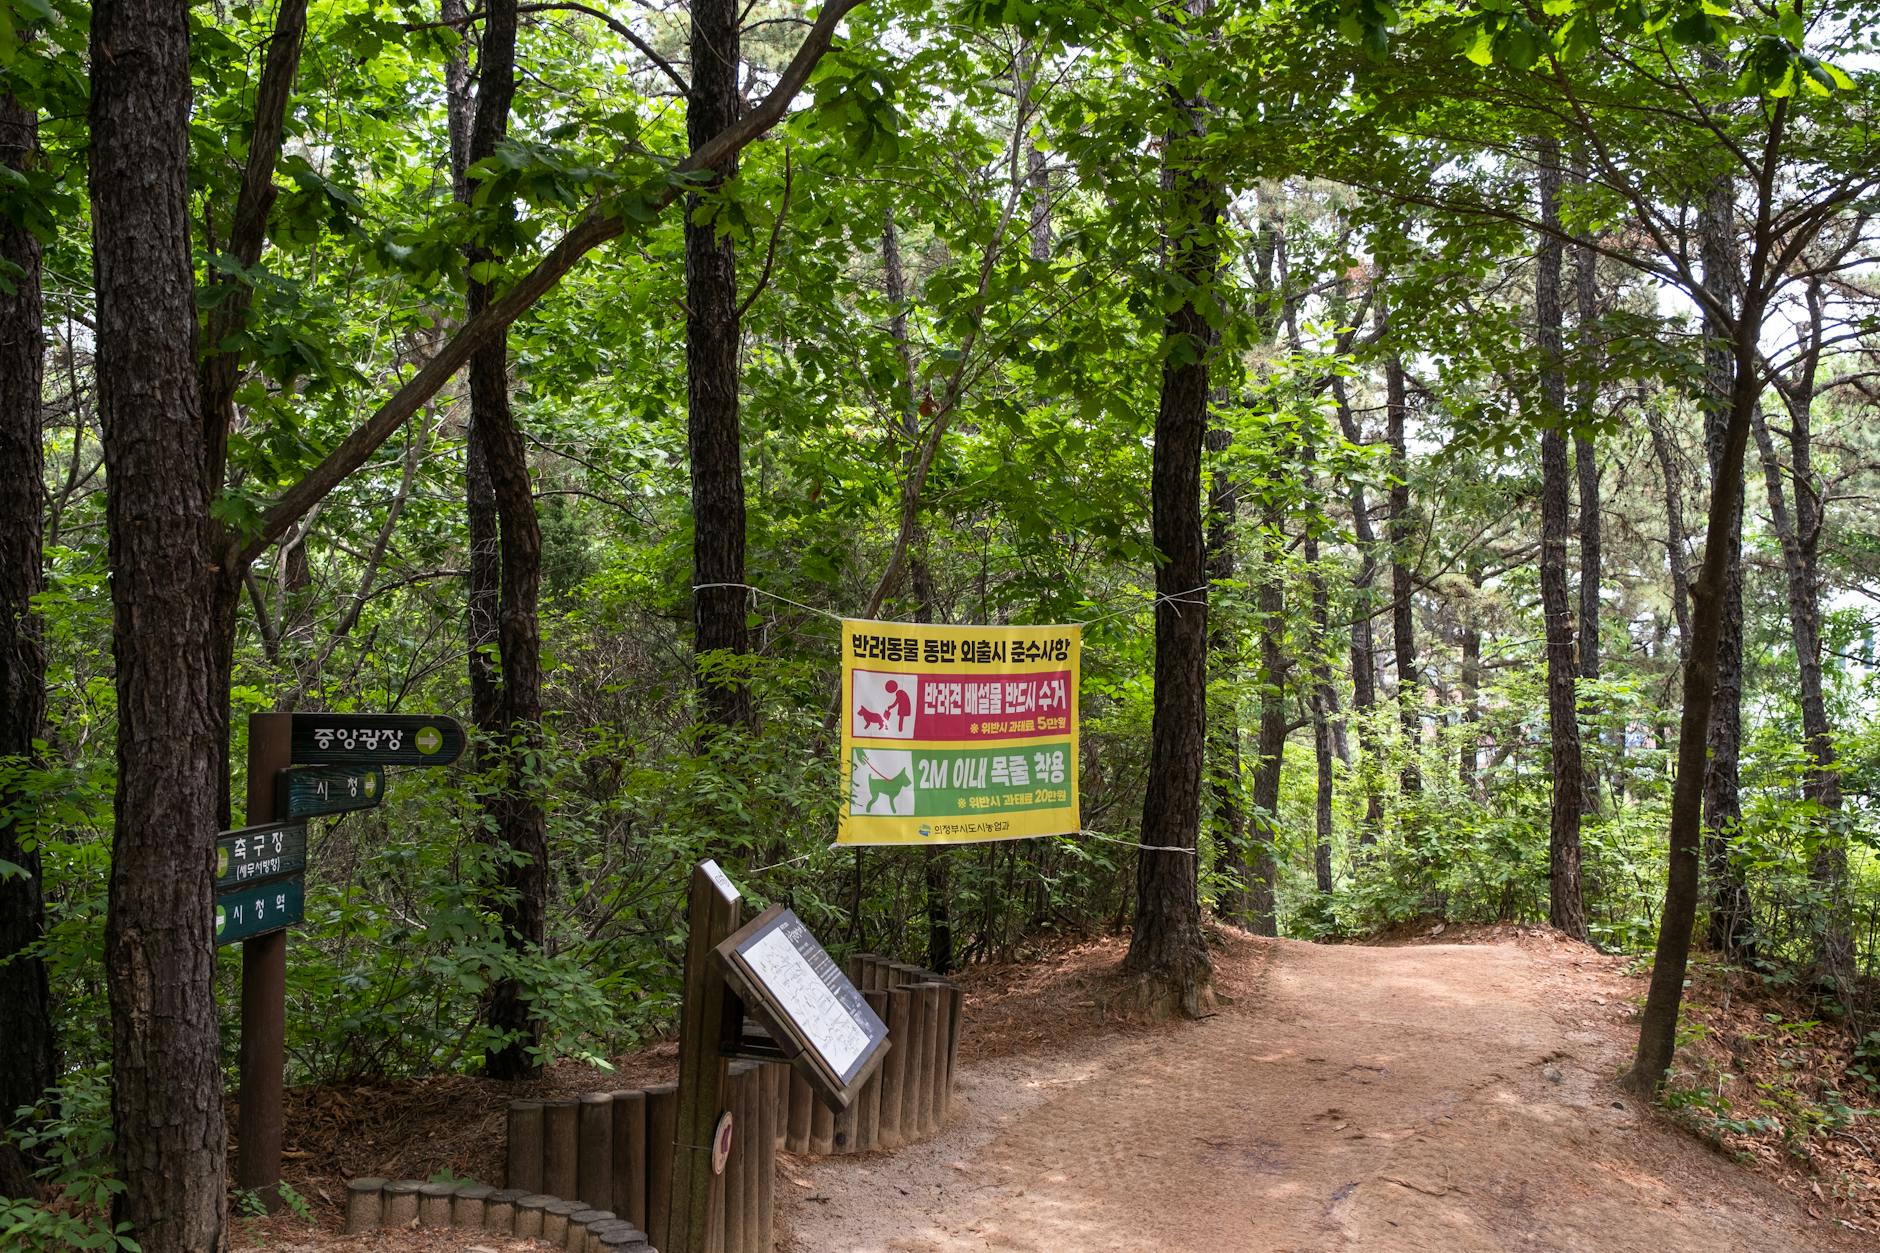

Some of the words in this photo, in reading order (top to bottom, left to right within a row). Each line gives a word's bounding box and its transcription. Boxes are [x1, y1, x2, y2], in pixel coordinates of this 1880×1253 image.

[852, 634, 919, 662] 반려동물
[923, 640, 957, 663] 동반
[960, 640, 1007, 663] 외출시
[1010, 638, 1071, 663] 준수사항
[923, 682, 962, 715] 반려견
[964, 682, 1002, 715] 배설물
[1005, 680, 1036, 714] 반드시
[1038, 679, 1067, 711] 수거
[981, 721, 1008, 735] 위반시
[1009, 720, 1035, 733] 과태료
[1037, 716, 1067, 731] 5만원
[314, 728, 404, 751] 중앙광장
[918, 758, 949, 789] 2M
[952, 757, 988, 789] 이내
[991, 755, 1030, 787] 목줄
[1033, 750, 1065, 784] 착용
[969, 795, 1001, 809] 위반시
[1003, 791, 1034, 807] 과태료
[1034, 788, 1067, 804] 20만원
[934, 821, 1010, 836] 의정부시도시농업과
[236, 856, 281, 881] (세무서방향)
